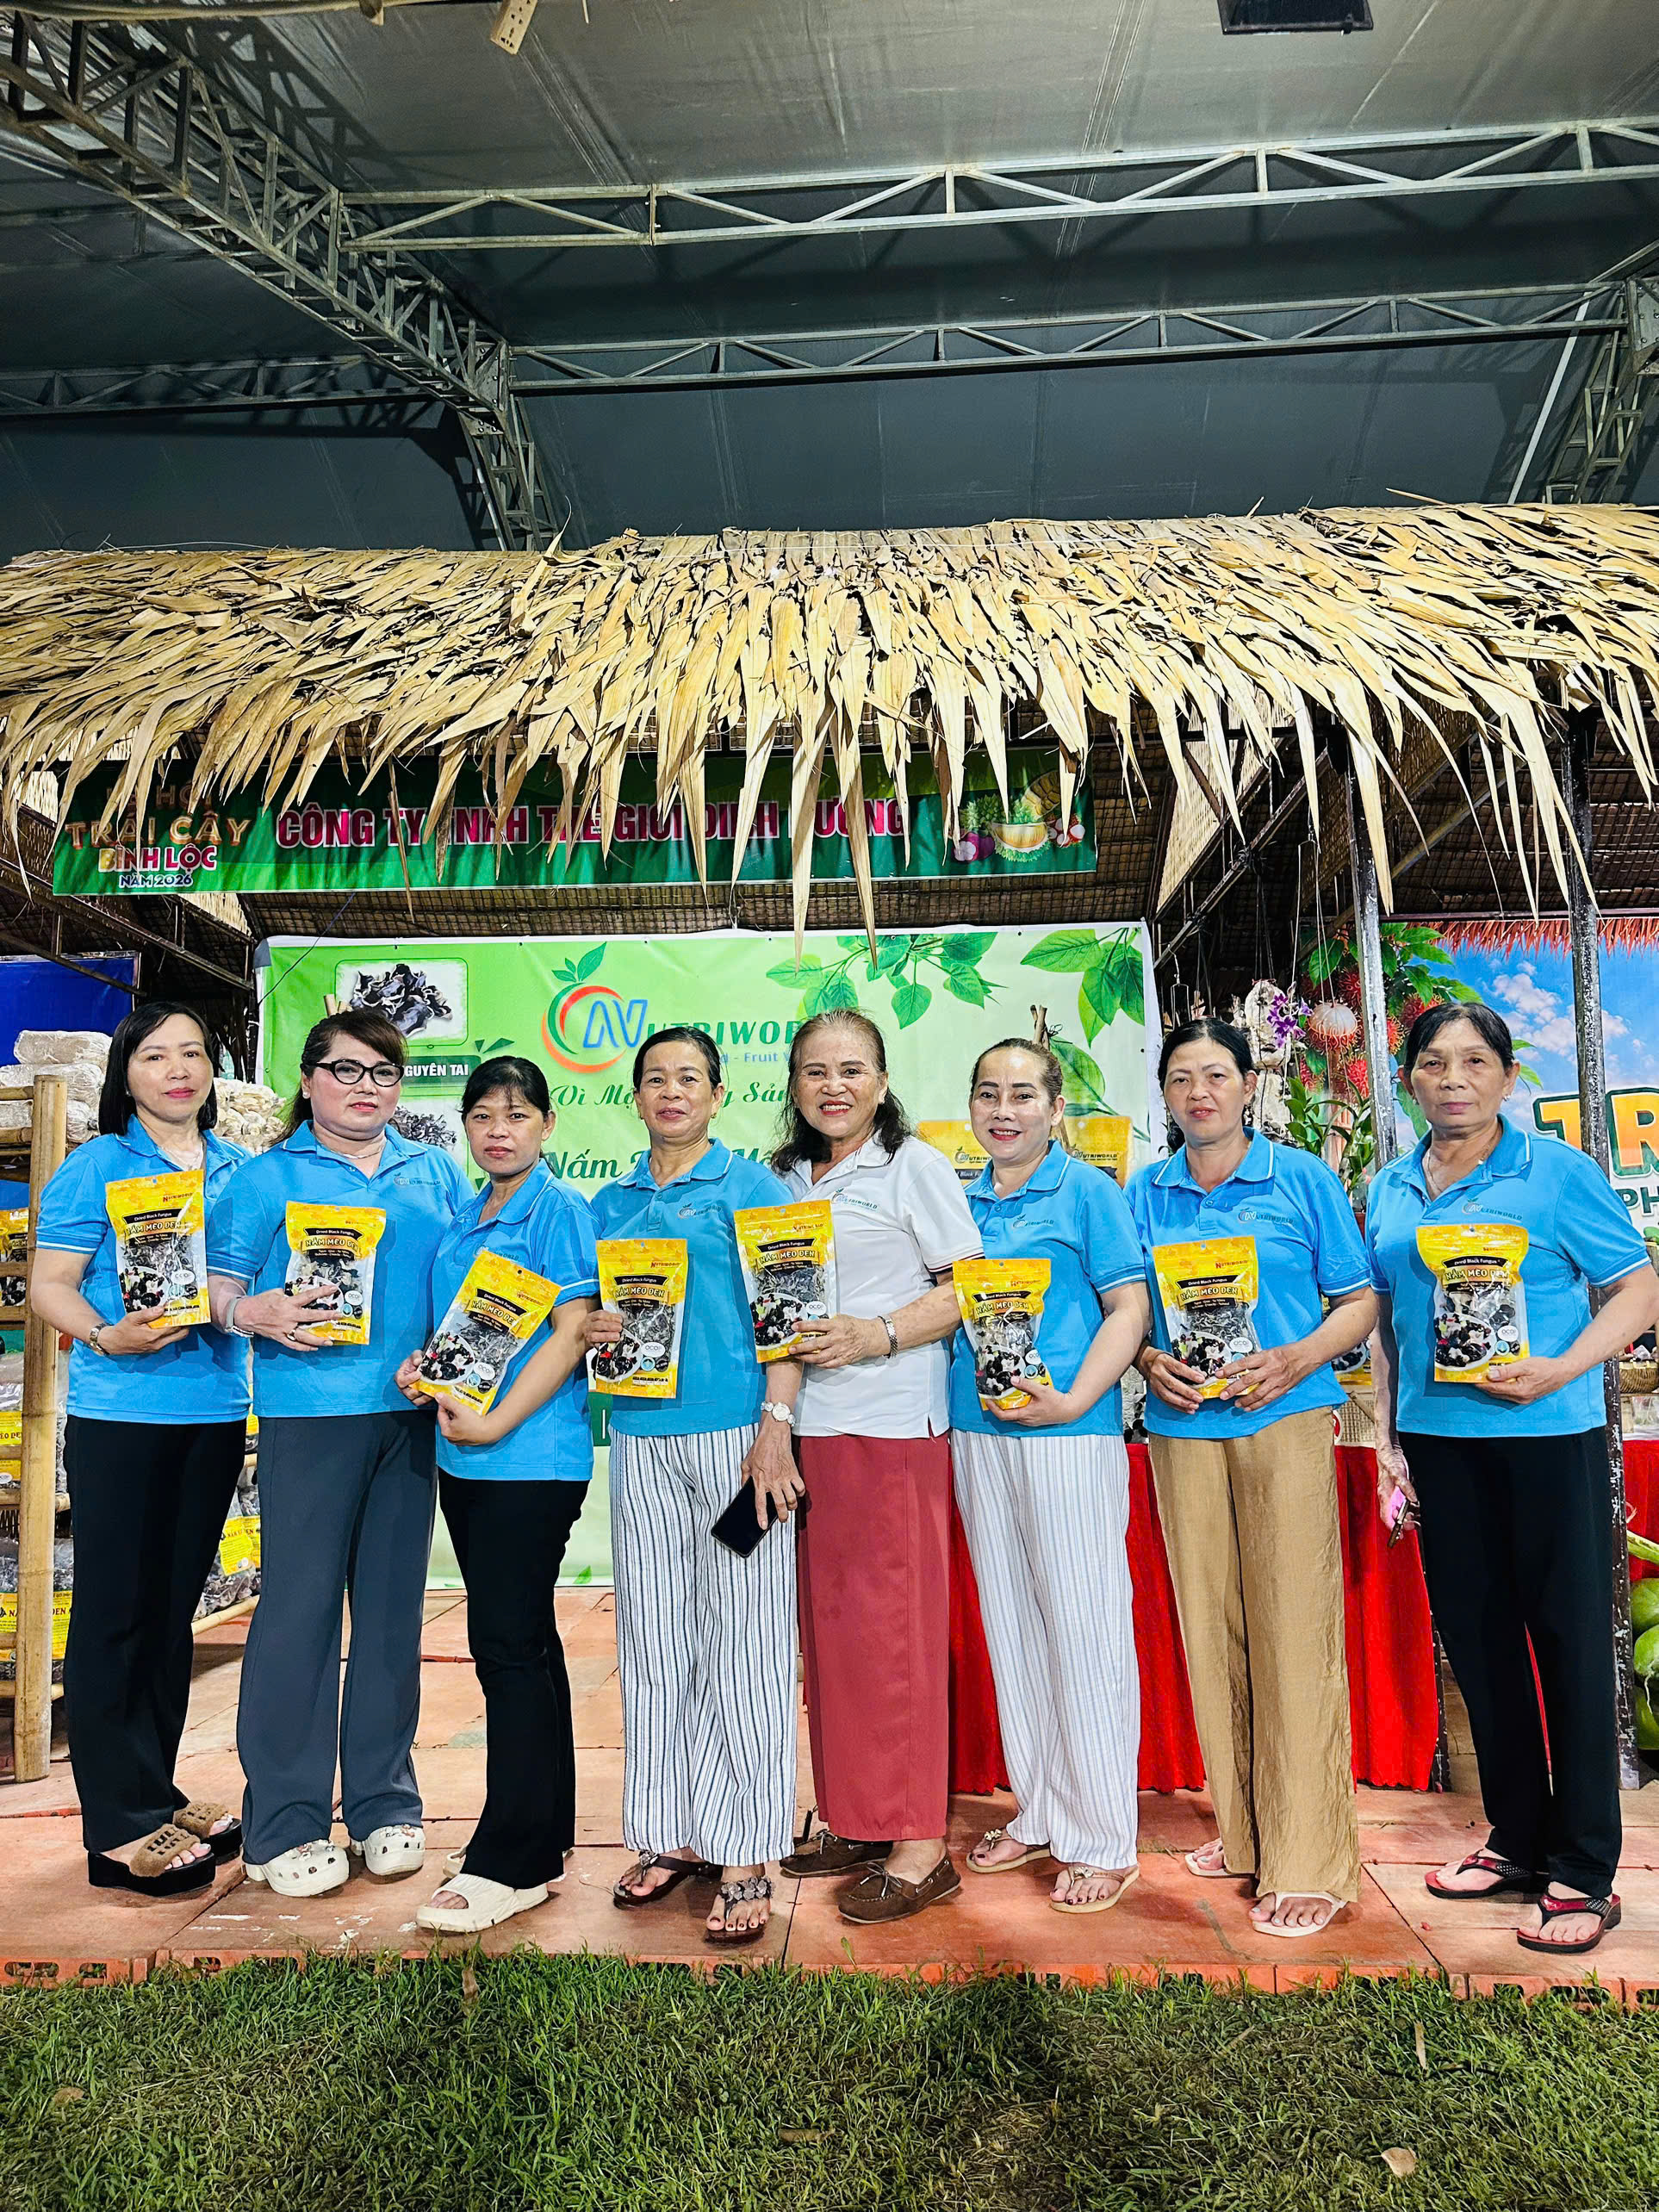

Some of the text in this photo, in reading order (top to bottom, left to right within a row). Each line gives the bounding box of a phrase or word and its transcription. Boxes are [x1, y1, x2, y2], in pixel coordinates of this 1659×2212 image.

[170, 811, 252, 845] CÂY
[276, 802, 375, 848] CÔNG
[383, 806, 428, 847] TY
[445, 805, 529, 846] NHH
[164, 842, 217, 874] LỘC
[154, 873, 193, 887] 2026
[743, 1053, 779, 1062] Fruit
[405, 1062, 469, 1077] GUYÊN TAI
